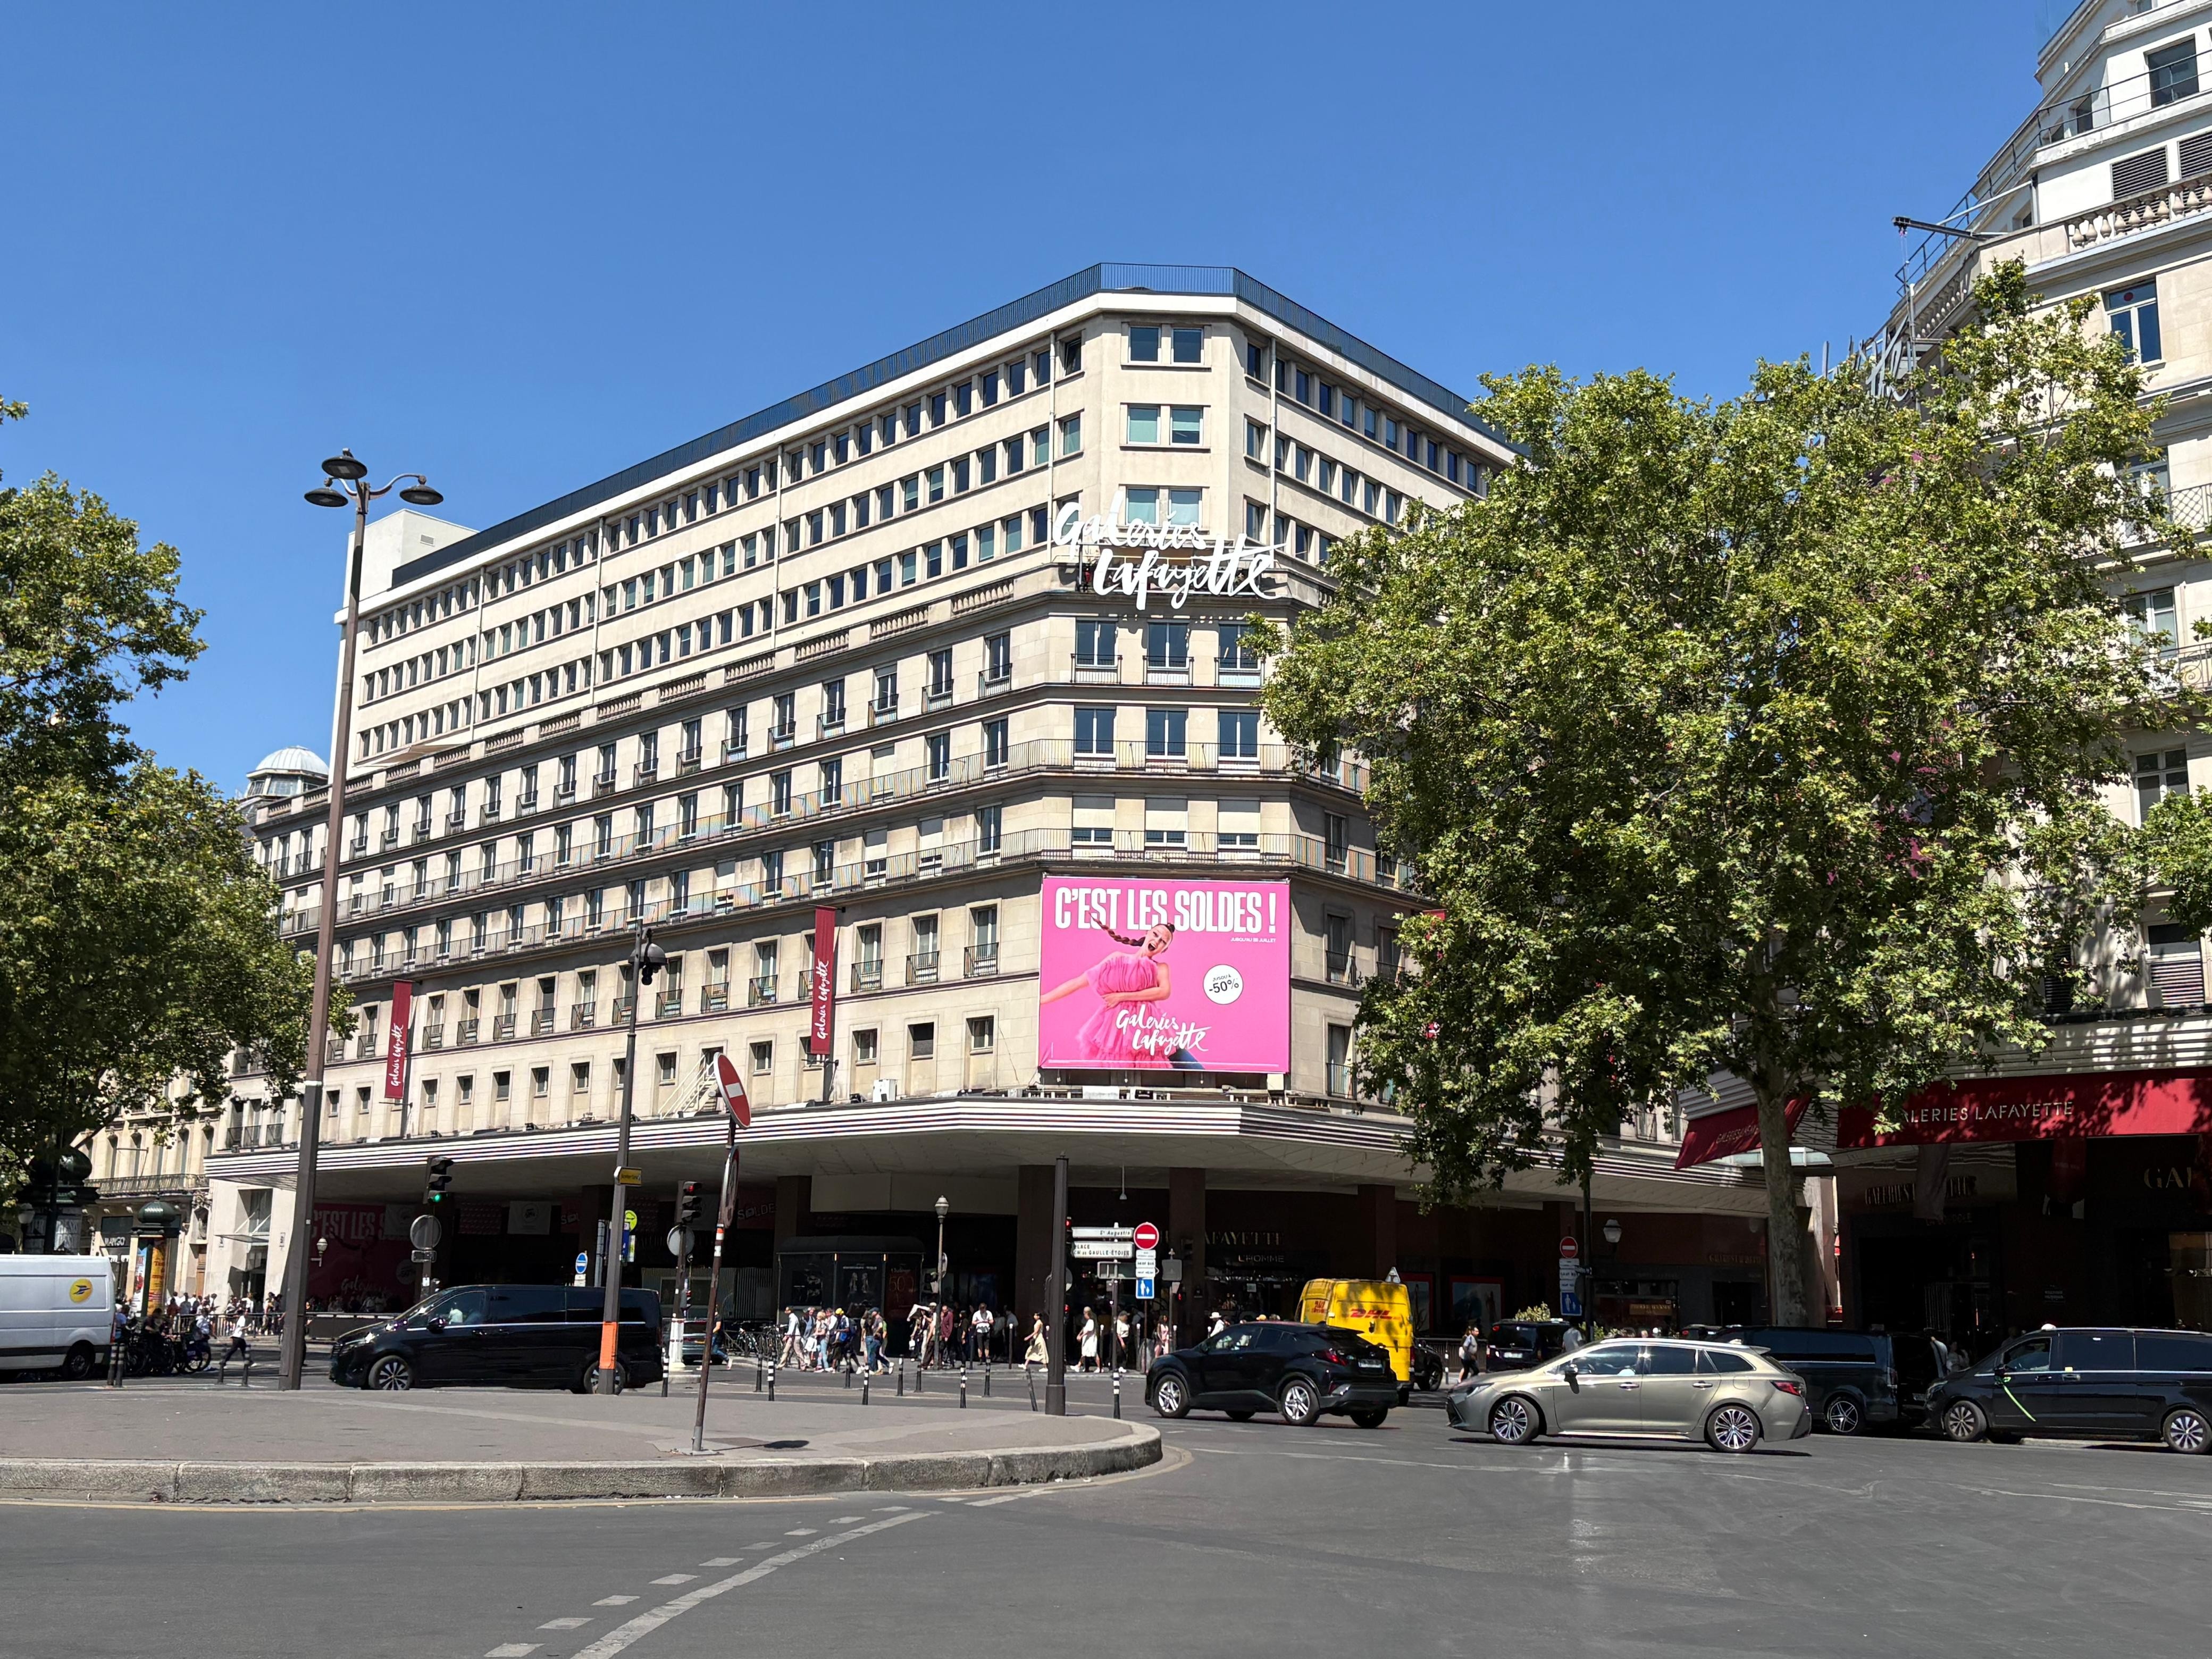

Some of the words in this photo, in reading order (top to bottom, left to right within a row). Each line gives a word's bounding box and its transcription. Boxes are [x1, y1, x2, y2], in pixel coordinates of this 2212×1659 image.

[1053, 489, 1207, 560] Galeries
[1093, 533, 1287, 611] Lafayette
[1127, 888, 1169, 931] LES
[1174, 890, 1263, 934] SOLDES
[1209, 978, 1239, 993] -50%
[1116, 1003, 1179, 1035] Galeries
[1132, 1021, 1212, 1056] Lafayette
[1901, 1107, 1968, 1124] ALERIES
[1975, 1101, 2073, 1120] LAFAYETTE
[350, 1211, 376, 1240] LES
[1205, 1230, 1285, 1245] AFAYETTE
[1350, 1308, 1392, 1319] DHL
